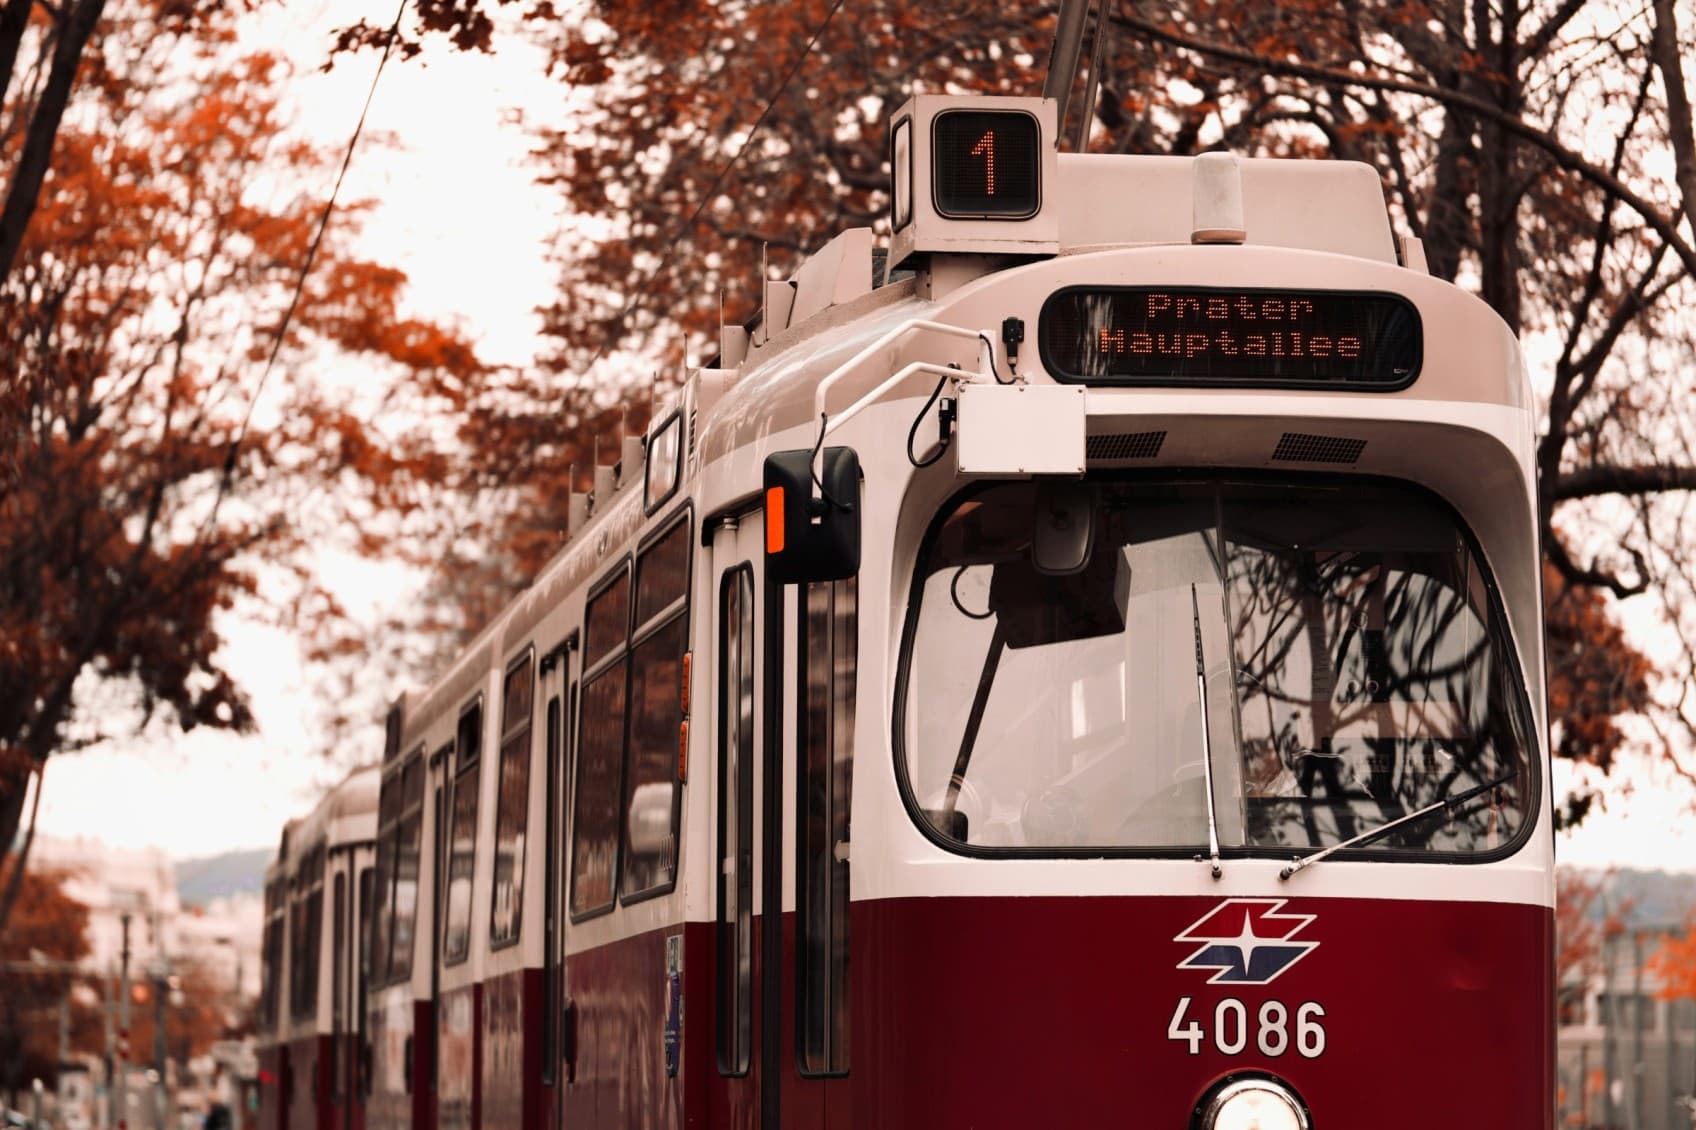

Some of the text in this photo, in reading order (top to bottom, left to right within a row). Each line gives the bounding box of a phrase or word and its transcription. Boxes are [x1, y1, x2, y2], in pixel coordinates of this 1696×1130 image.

[971, 130, 994, 195] 1
[1148, 294, 1313, 320] Prater
[1100, 327, 1360, 358] Hauptallee
[1167, 996, 1327, 1059] 4086
